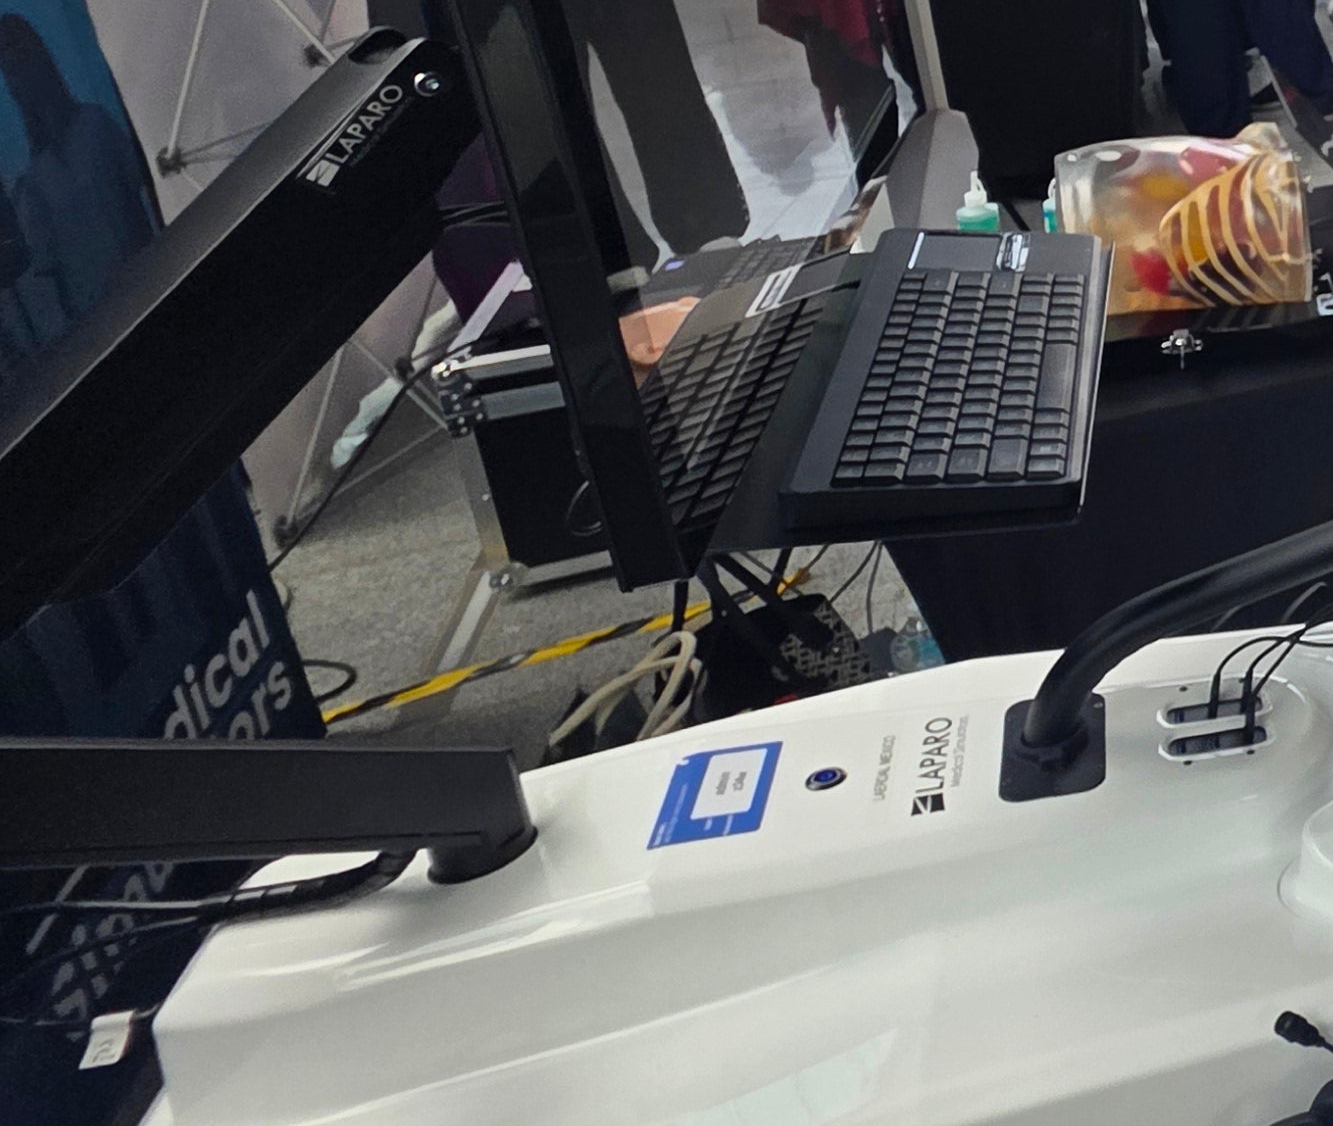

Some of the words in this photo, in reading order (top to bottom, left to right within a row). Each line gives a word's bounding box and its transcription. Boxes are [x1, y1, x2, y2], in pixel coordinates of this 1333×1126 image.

[325, 85, 404, 164] LAPARO
[164, 589, 270, 740] dical
[229, 660, 293, 740] ors
[914, 716, 953, 794] LAPARO
